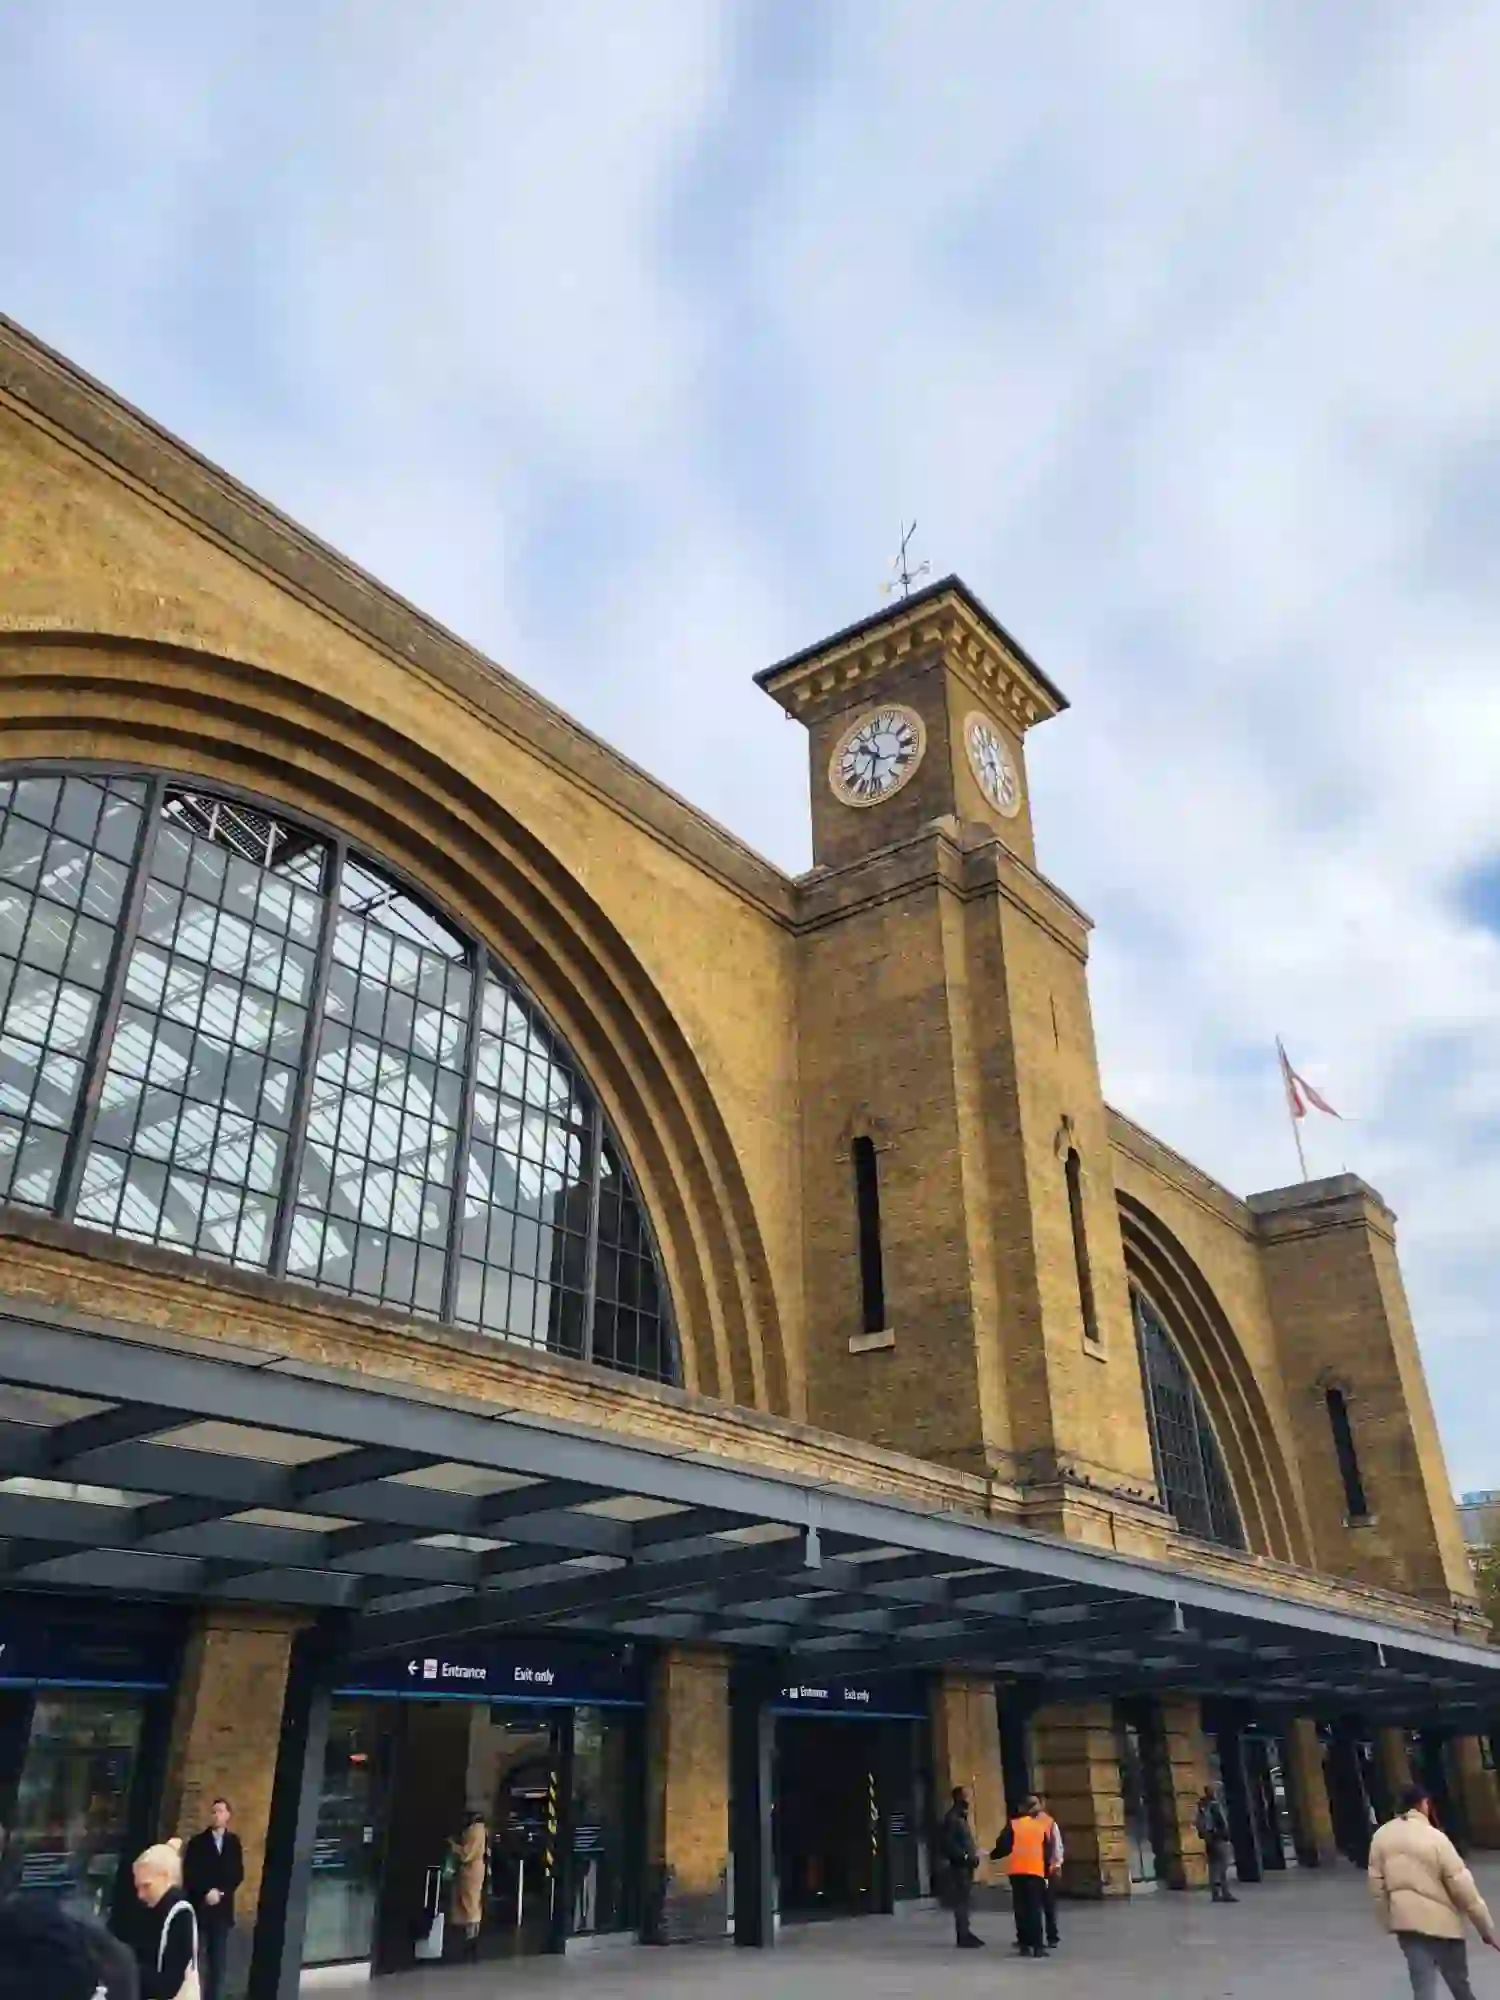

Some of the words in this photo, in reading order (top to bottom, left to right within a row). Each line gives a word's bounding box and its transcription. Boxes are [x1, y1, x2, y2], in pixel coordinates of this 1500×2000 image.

[441, 1662, 487, 1680] Entrance
[514, 1666, 533, 1682] Exit
[535, 1668, 555, 1685] only
